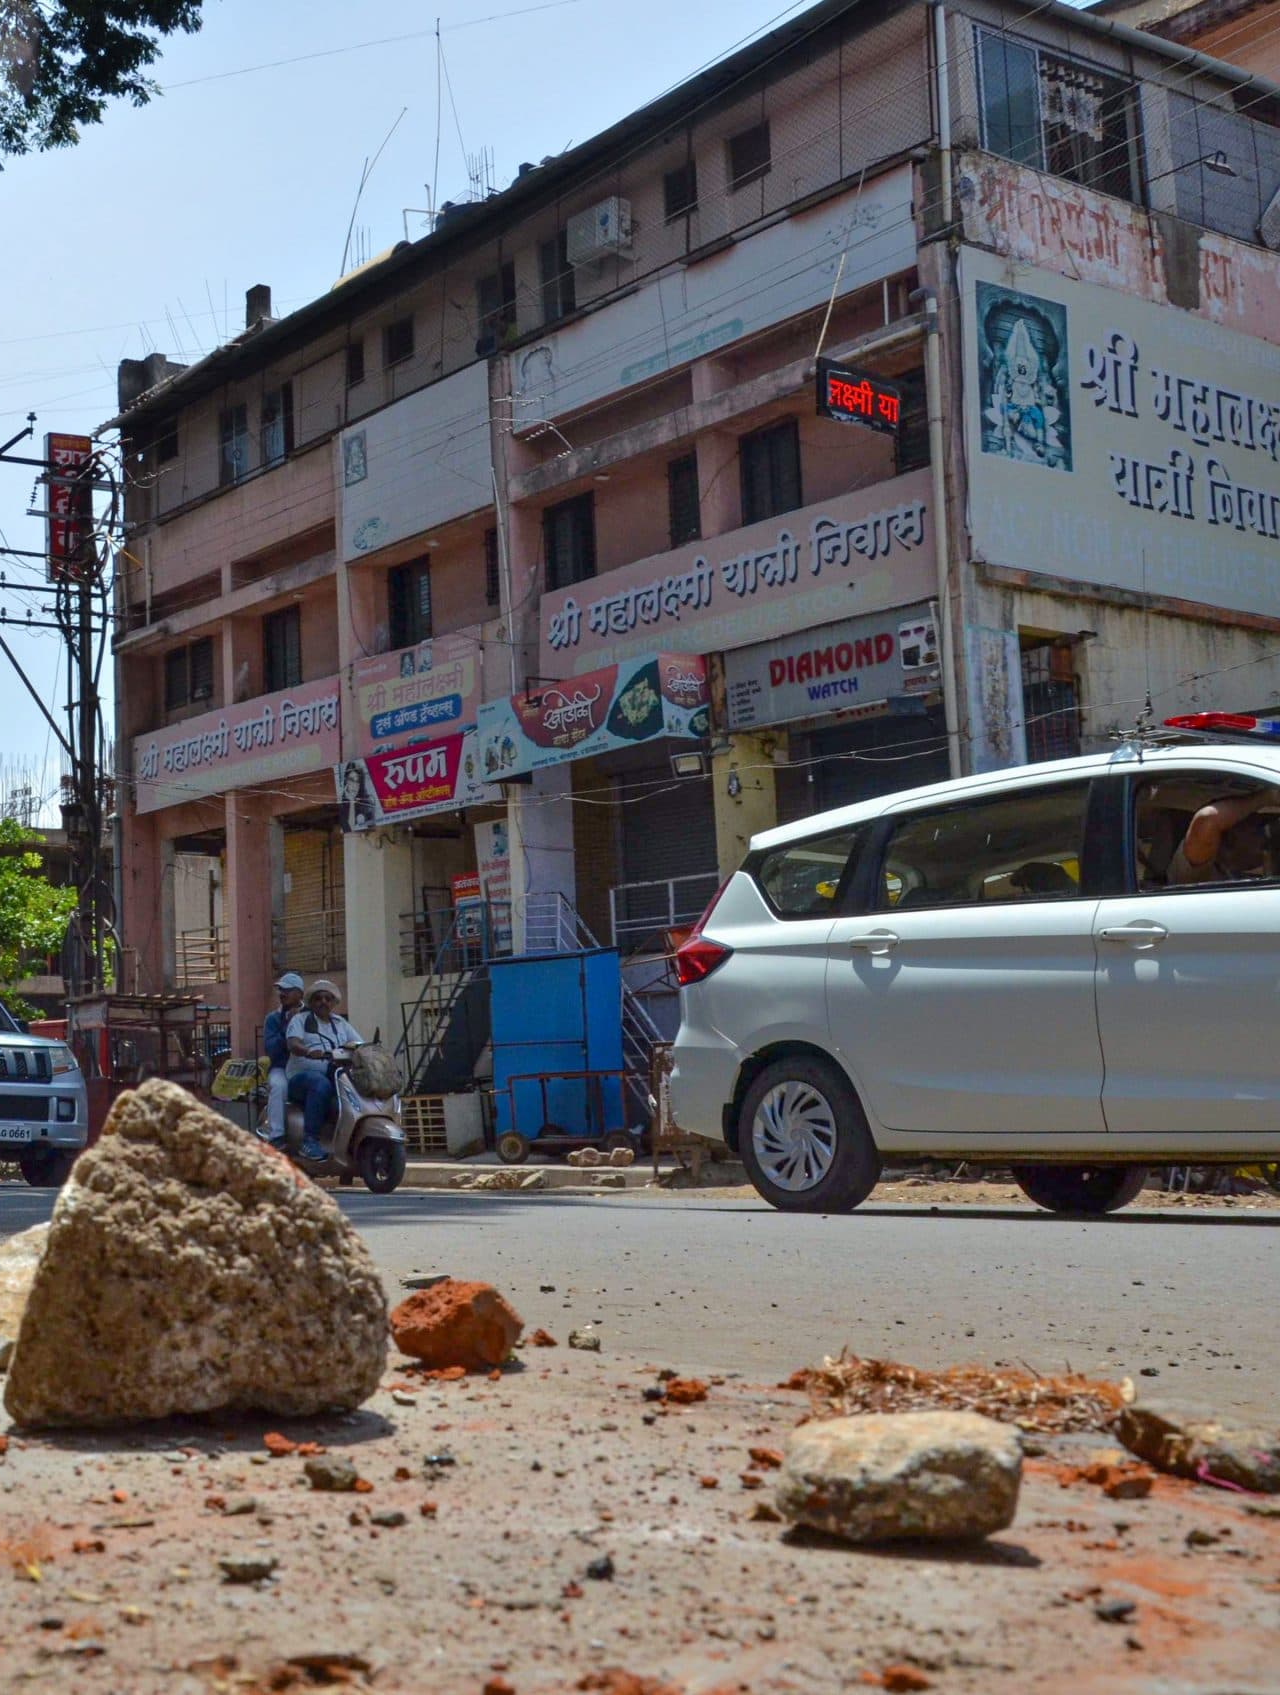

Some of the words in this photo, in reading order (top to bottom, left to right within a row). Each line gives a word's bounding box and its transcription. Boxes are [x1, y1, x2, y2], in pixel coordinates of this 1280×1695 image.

[1080, 327, 1139, 418] श्री
[877, 392, 899, 422] या
[1109, 450, 1195, 520] यात्री
[547, 594, 584, 650] श्री
[588, 555, 717, 636] महालक्ष्मी
[720, 528, 802, 597] यात्री
[808, 499, 926, 577] निवास
[367, 681, 387, 709] श्री
[392, 662, 464, 704] महालक्ष्मी
[768, 633, 895, 688] DIAMOND
[807, 676, 859, 701] WATCH
[140, 743, 160, 780] श्री
[163, 721, 231, 775] महालक्ष्मी
[234, 704, 275, 752] यात्री
[279, 694, 339, 743] निवास
[381, 746, 448, 790] रुपम
